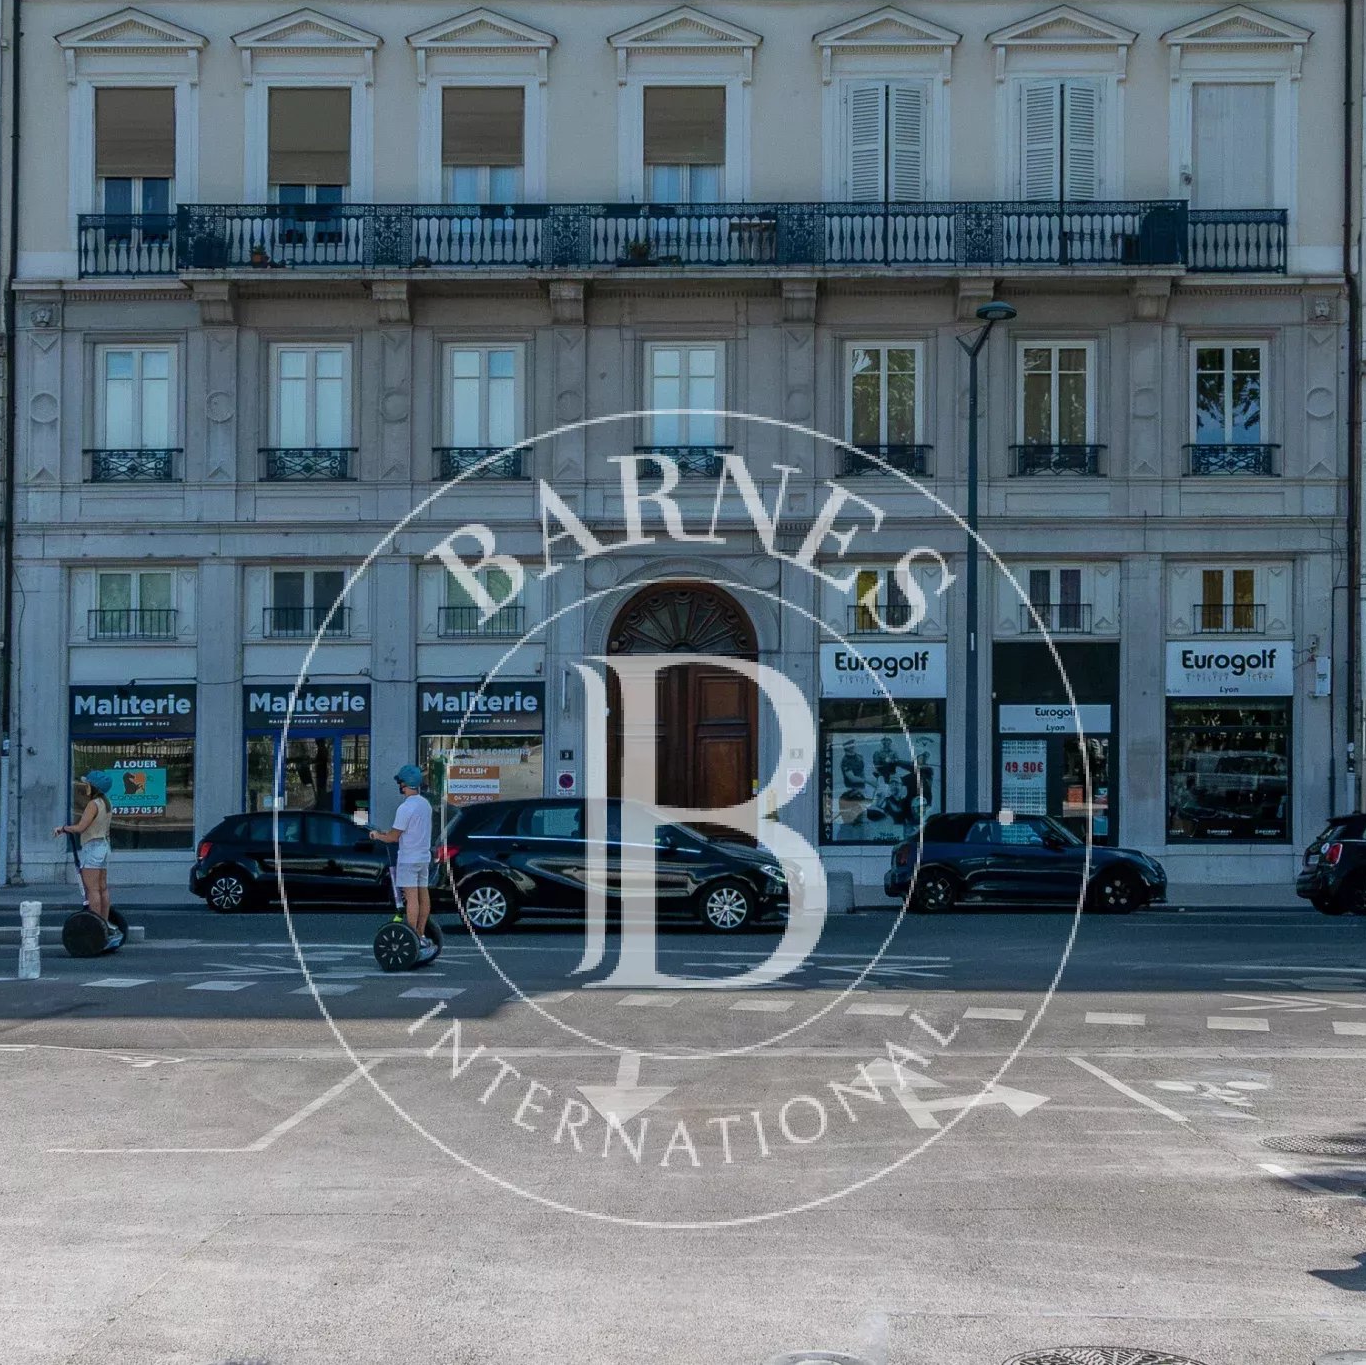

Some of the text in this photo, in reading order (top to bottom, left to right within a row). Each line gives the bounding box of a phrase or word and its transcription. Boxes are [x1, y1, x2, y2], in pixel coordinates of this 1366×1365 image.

[835, 651, 929, 678] Eurogolf
[1182, 648, 1277, 676] Eurogolf
[1219, 686, 1239, 694] Lyon
[74, 694, 191, 715] Maliterie
[249, 691, 365, 712] Maliterie
[422, 691, 538, 712] Maliterie
[1046, 724, 1065, 732] Lyon
[123, 760, 157, 768] LOUER
[1004, 761, 1044, 773] 49.90€
